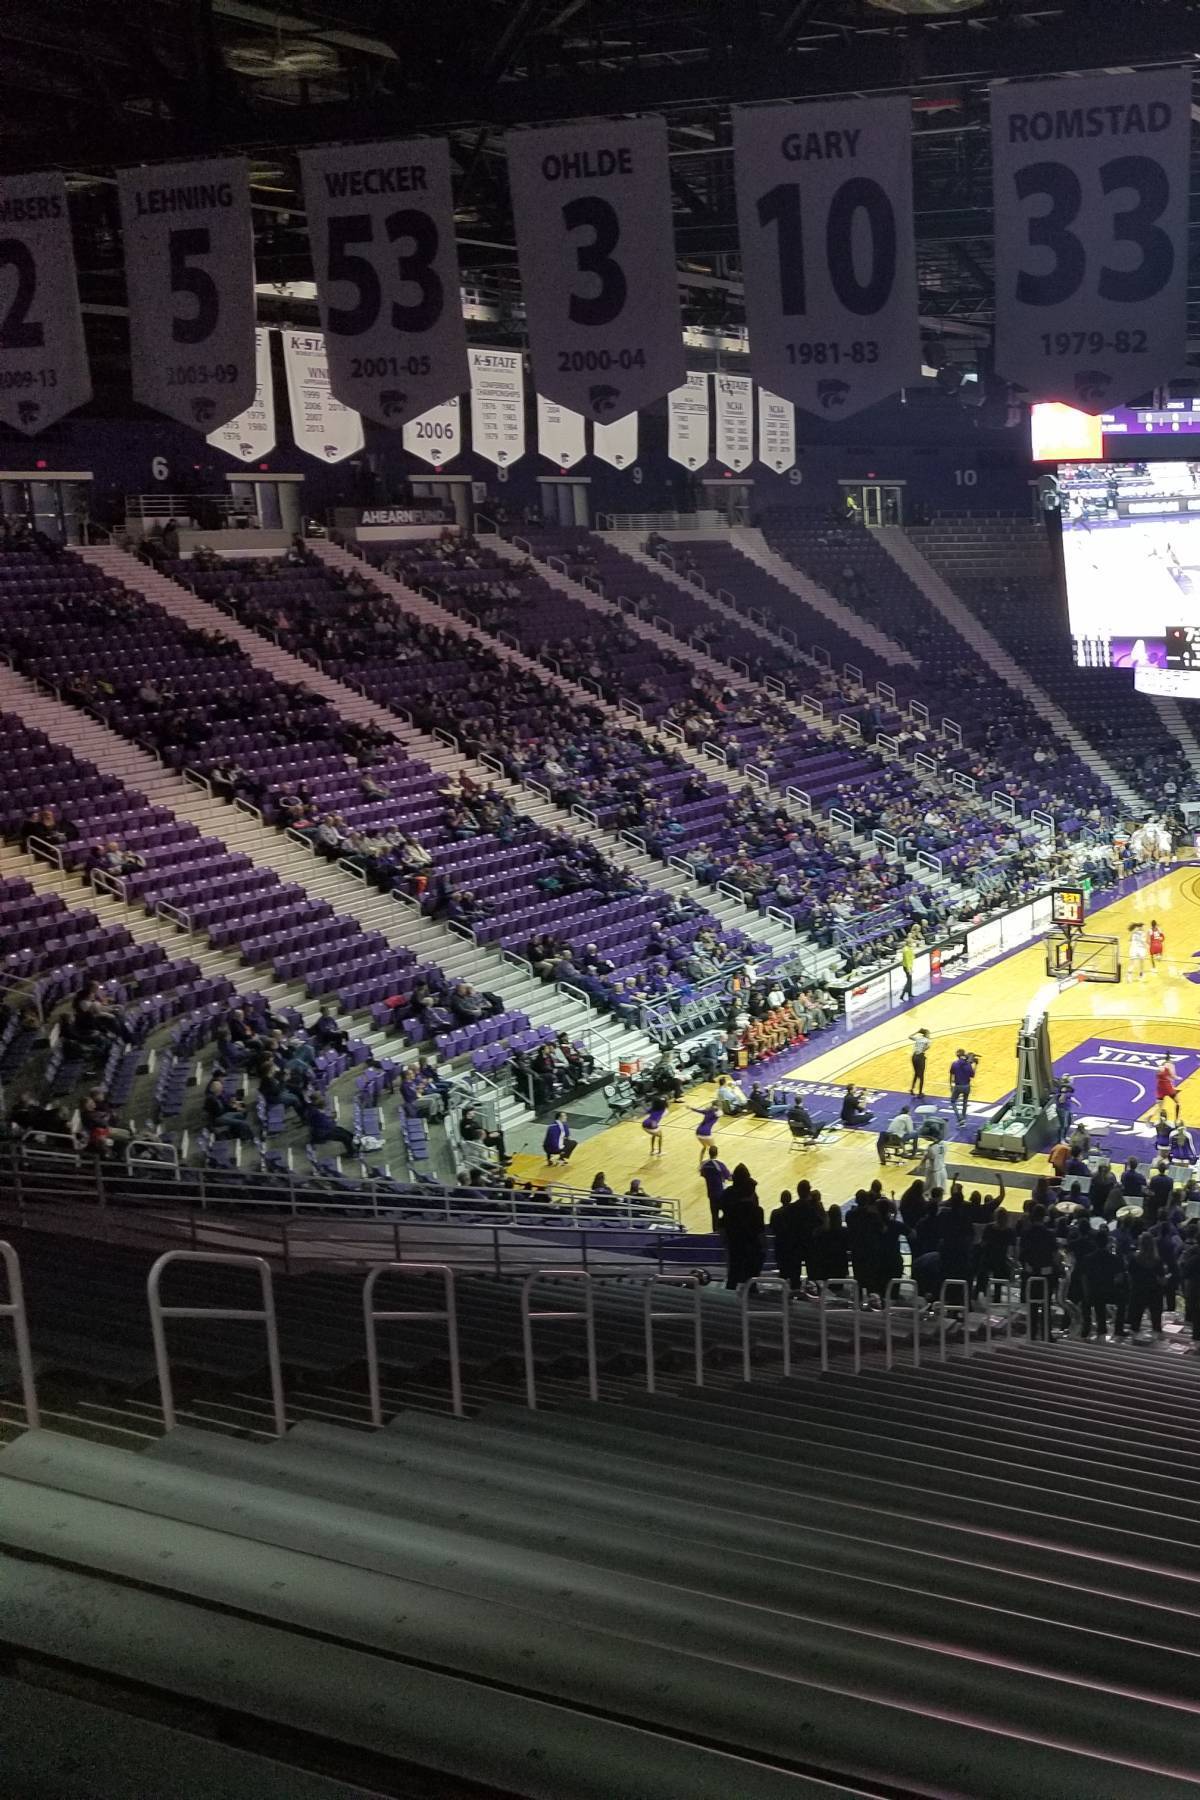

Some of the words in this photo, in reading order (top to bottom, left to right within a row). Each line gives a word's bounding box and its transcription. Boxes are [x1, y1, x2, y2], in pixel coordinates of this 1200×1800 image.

[1009, 103, 1172, 143] ROMSTAD
[781, 129, 862, 161] GARY
[542, 148, 633, 181] OHLDE
[324, 165, 430, 198] WECKER
[135, 183, 233, 215] LEHNING
[1014, 155, 1174, 306] 33
[756, 176, 897, 316] 10
[327, 209, 444, 336] 53
[561, 196, 627, 326] 3
[168, 228, 219, 344] 5
[785, 341, 880, 365] 1981-83
[1041, 330, 1148, 356] 1979-82
[351, 356, 431, 379] 2001-05
[472, 354, 518, 369] K-STATE
[558, 349, 647, 373] 2000-04
[416, 422, 454, 439] 2006
[151, 456, 169, 480] 6
[633, 467, 643, 484] 9
[788, 468, 802, 485] 9
[954, 469, 977, 486] 10
